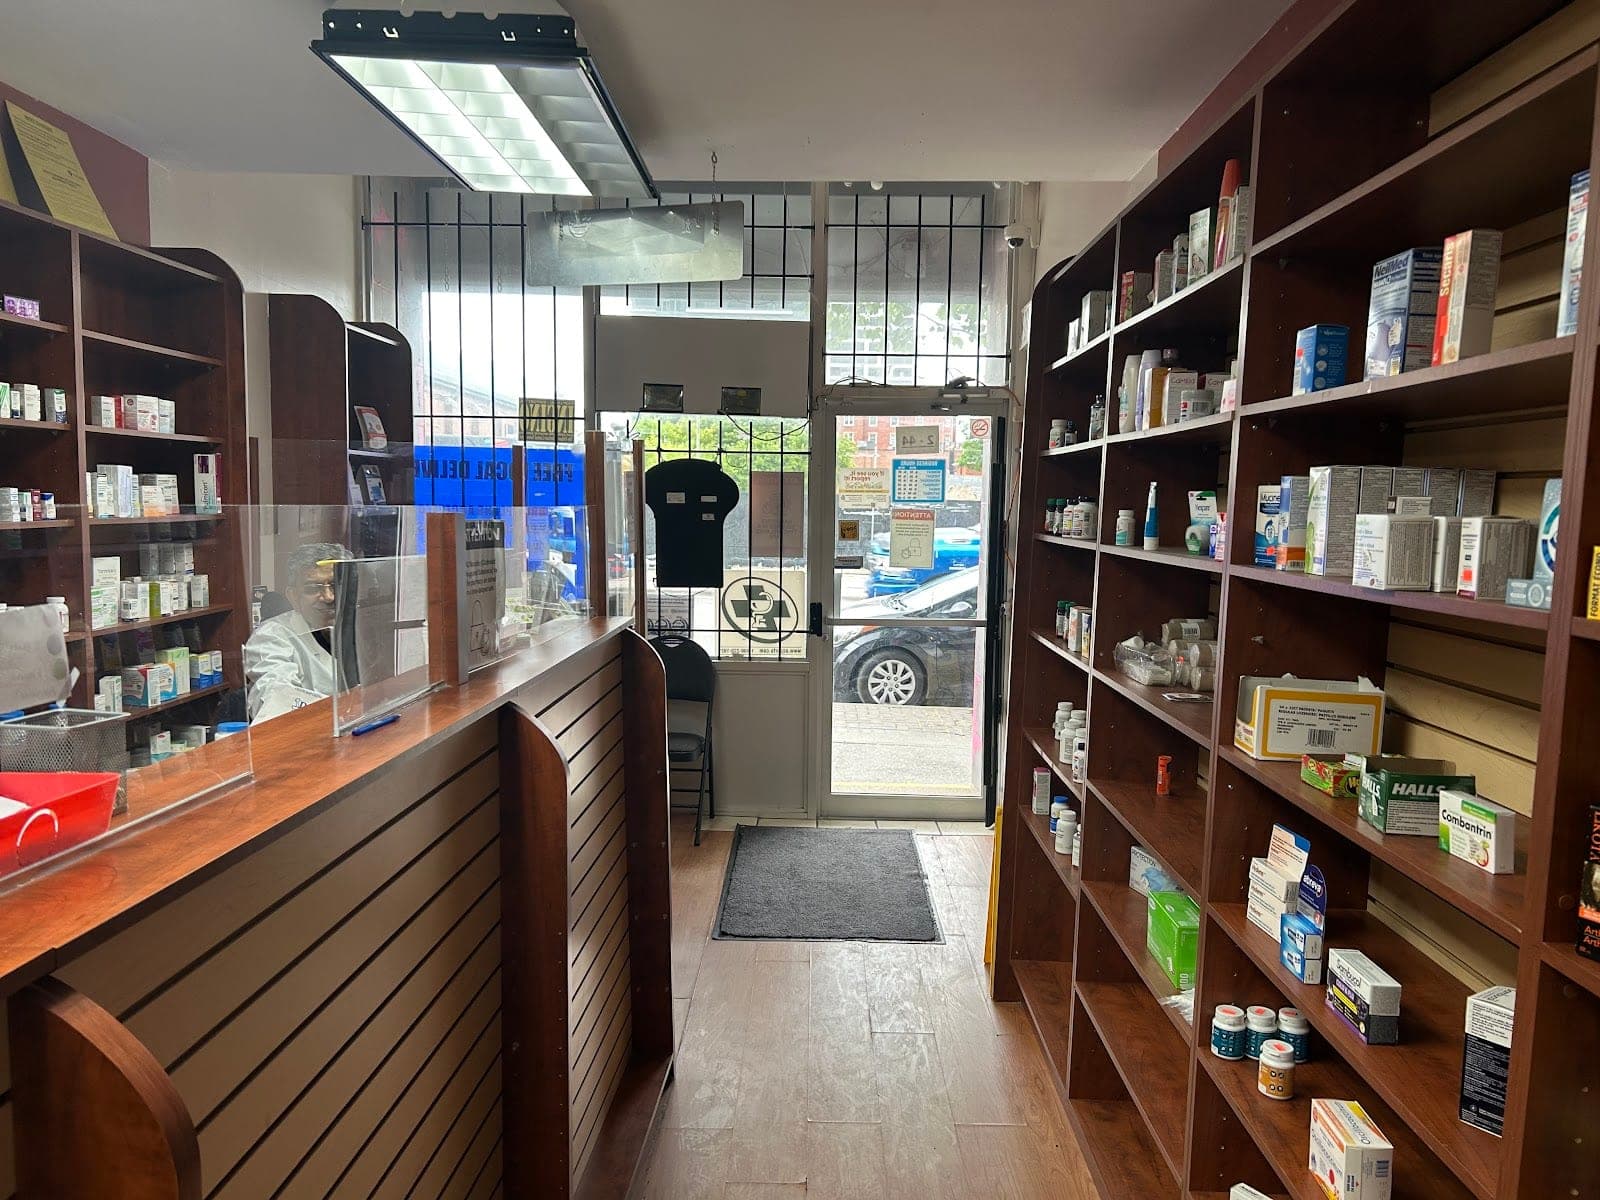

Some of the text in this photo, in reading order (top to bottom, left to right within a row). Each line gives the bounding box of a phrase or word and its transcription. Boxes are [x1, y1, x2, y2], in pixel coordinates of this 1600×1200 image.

[1374, 255, 1409, 278] NeilMed
[1361, 774, 1381, 797] HALLS
[1392, 782, 1447, 797] HALLS
[1441, 809, 1492, 840] Combantrin
